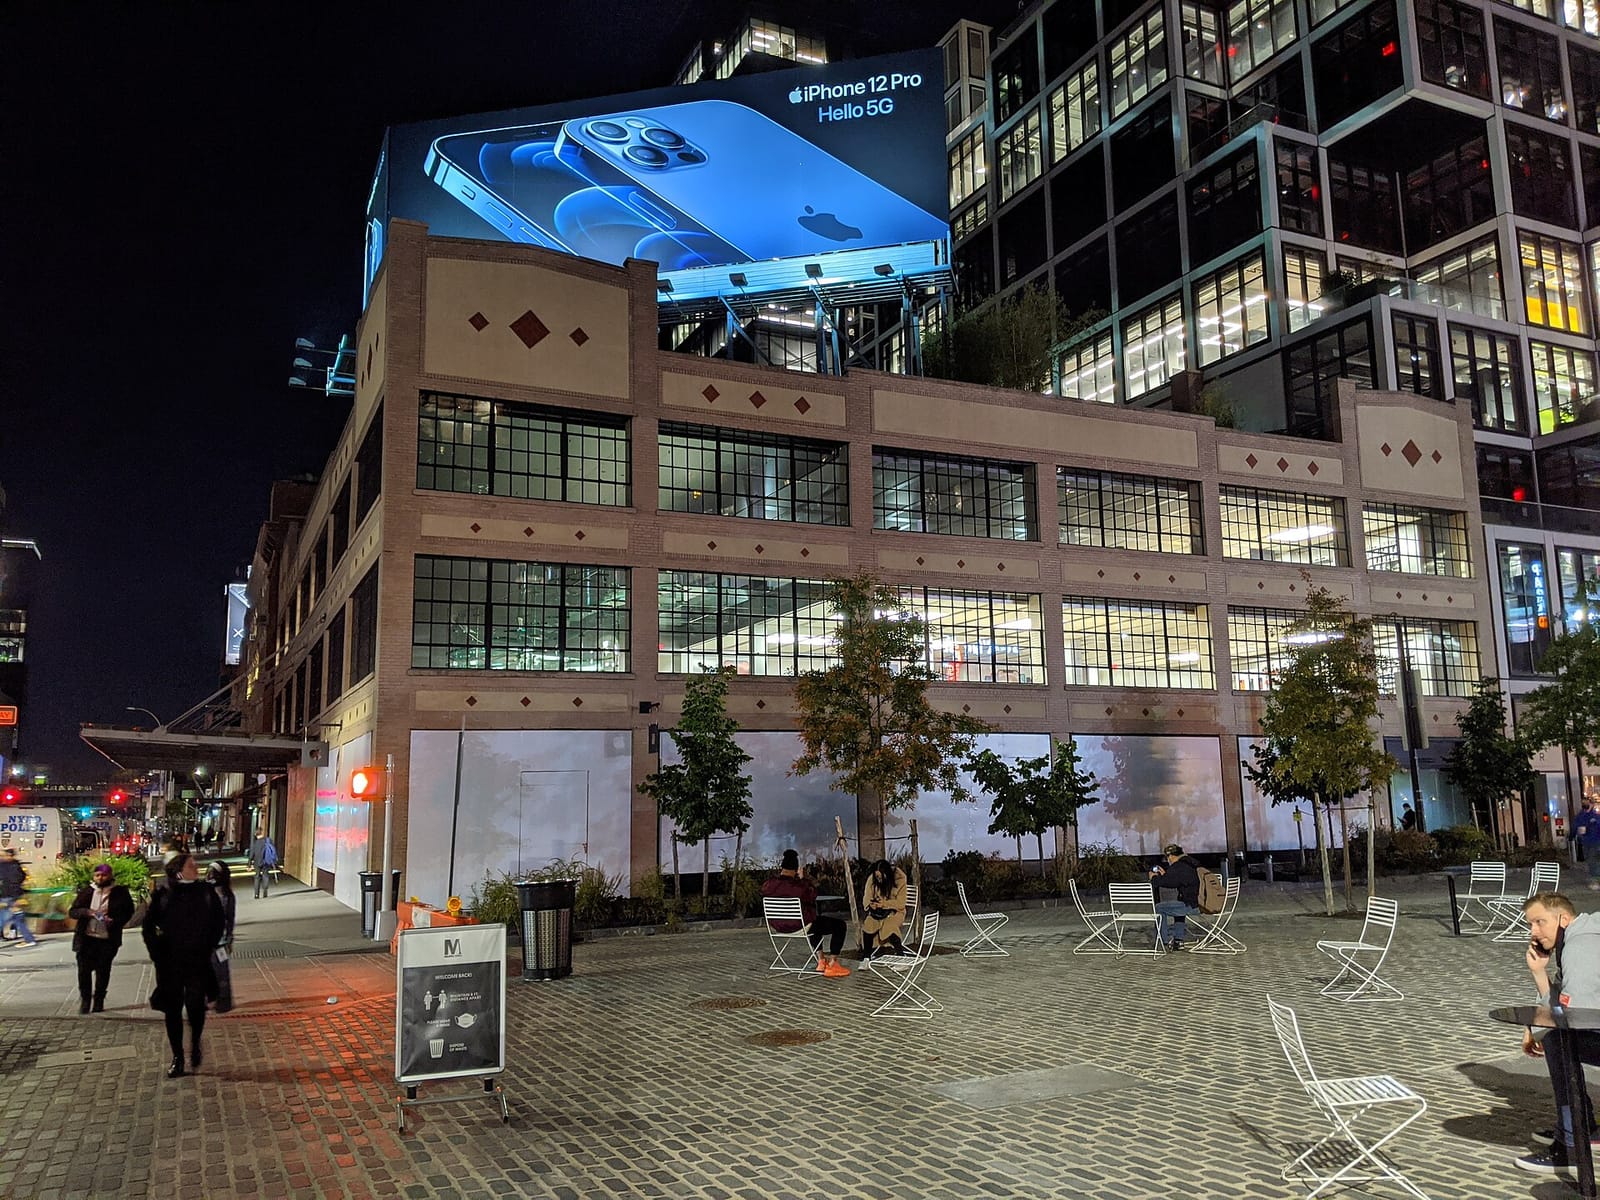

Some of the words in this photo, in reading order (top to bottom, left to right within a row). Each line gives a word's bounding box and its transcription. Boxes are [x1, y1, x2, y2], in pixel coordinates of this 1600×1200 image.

[804, 82, 866, 102] iPhone
[868, 75, 888, 93] 12
[891, 73, 922, 90] Pro
[818, 102, 864, 123] Hello
[866, 97, 894, 116] 5G
[444, 938, 462, 955] M
